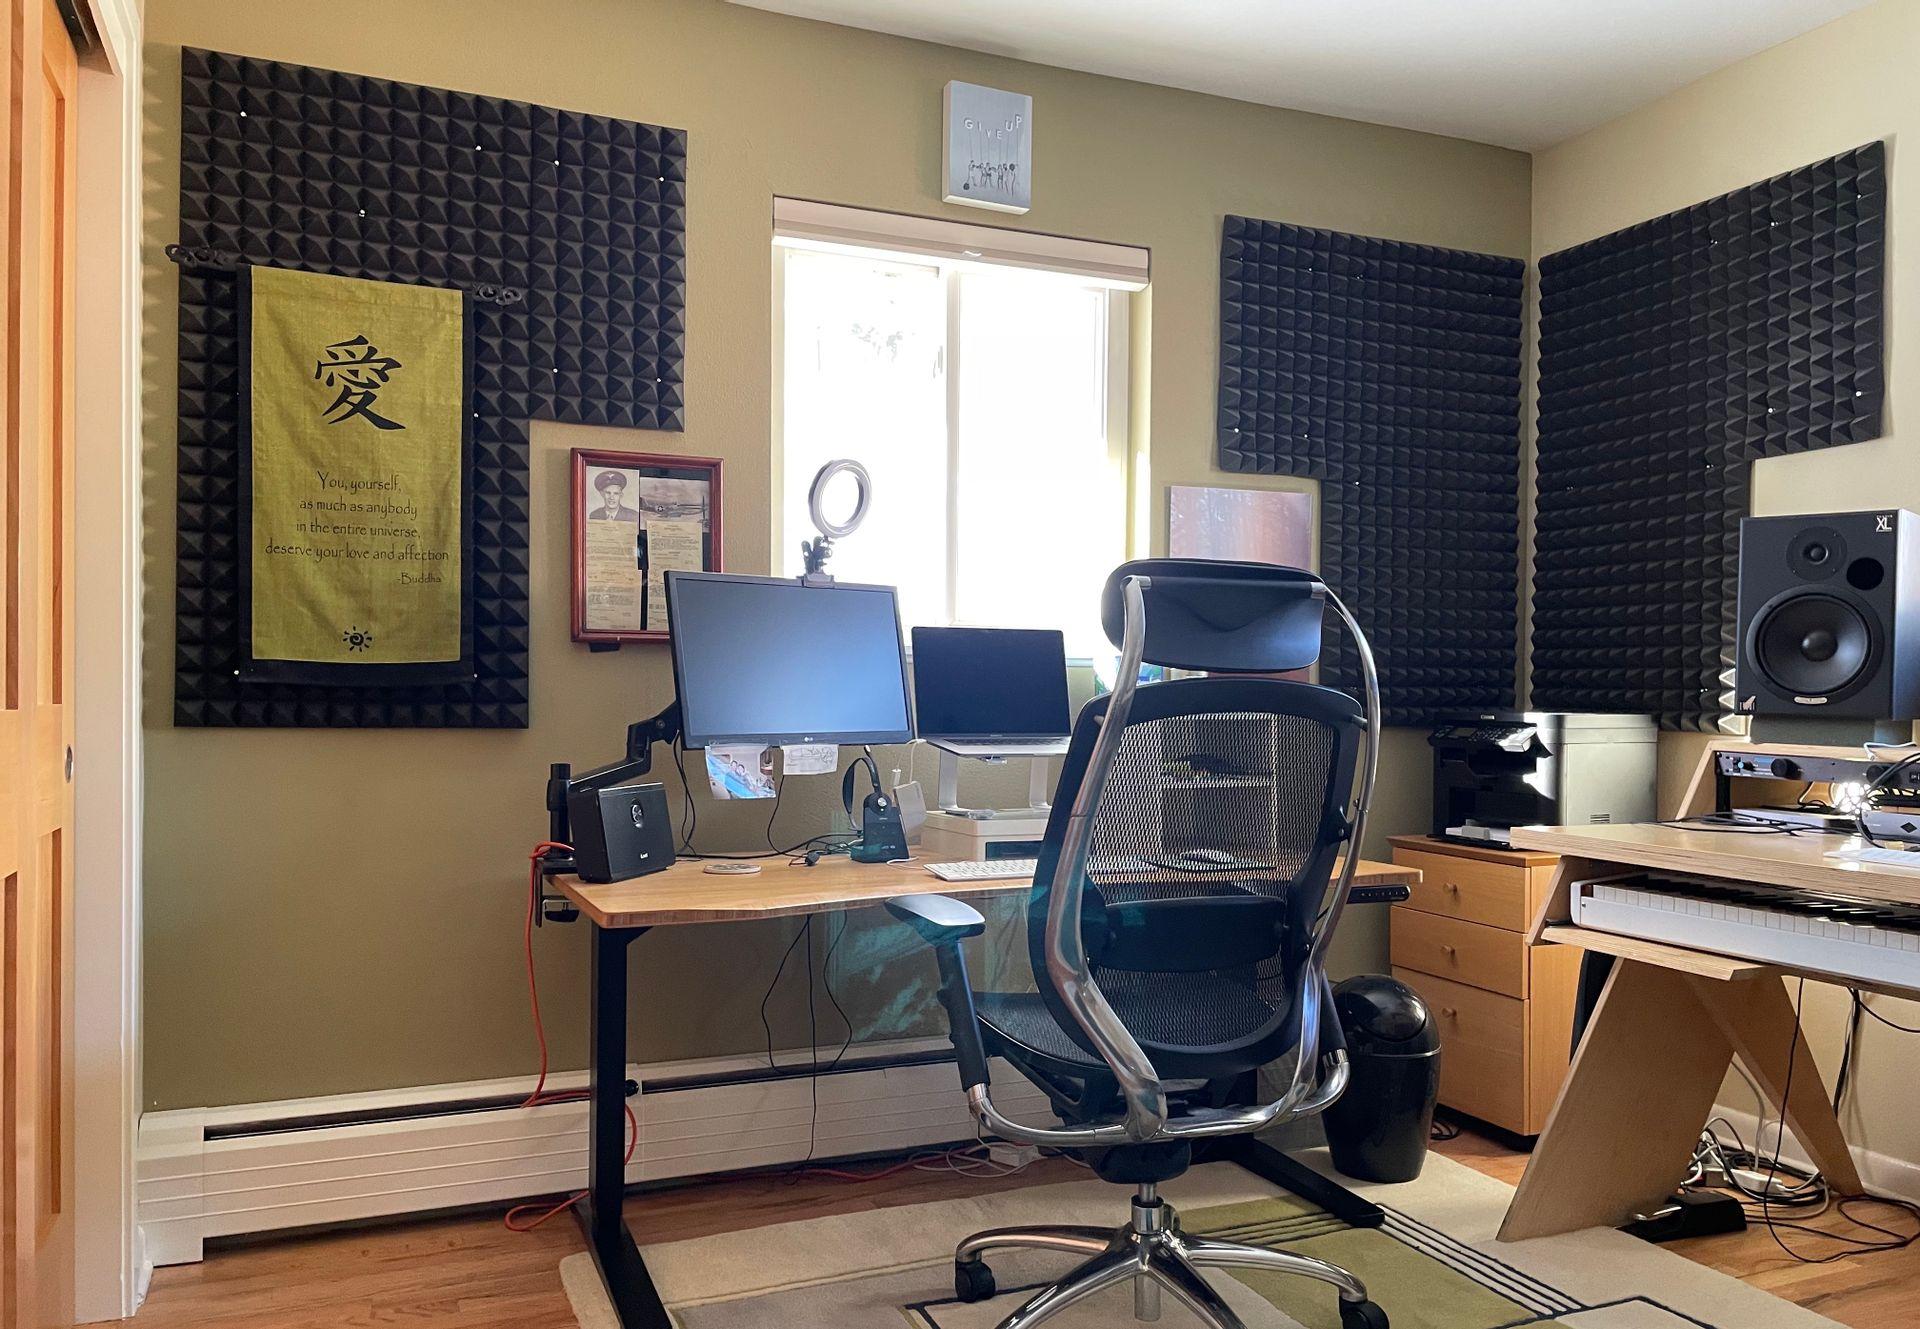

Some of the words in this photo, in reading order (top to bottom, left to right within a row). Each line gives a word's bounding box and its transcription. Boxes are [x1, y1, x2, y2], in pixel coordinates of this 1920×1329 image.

[964, 117, 1003, 140] GIVE
[1004, 113, 1022, 132] UP
[314, 334, 406, 430] 愛
[317, 470, 348, 491] You,
[299, 500, 313, 510] as
[316, 496, 347, 512] much
[349, 502, 364, 513] as
[366, 497, 418, 521] anybody
[296, 522, 307, 533] in
[310, 517, 329, 534] the
[332, 523, 367, 536] entire
[1876, 517, 1893, 532] XL
[265, 537, 312, 556] deserve
[315, 547, 343, 563] your
[346, 542, 369, 559] love
[372, 543, 395, 560] and
[397, 544, 449, 561] affection
